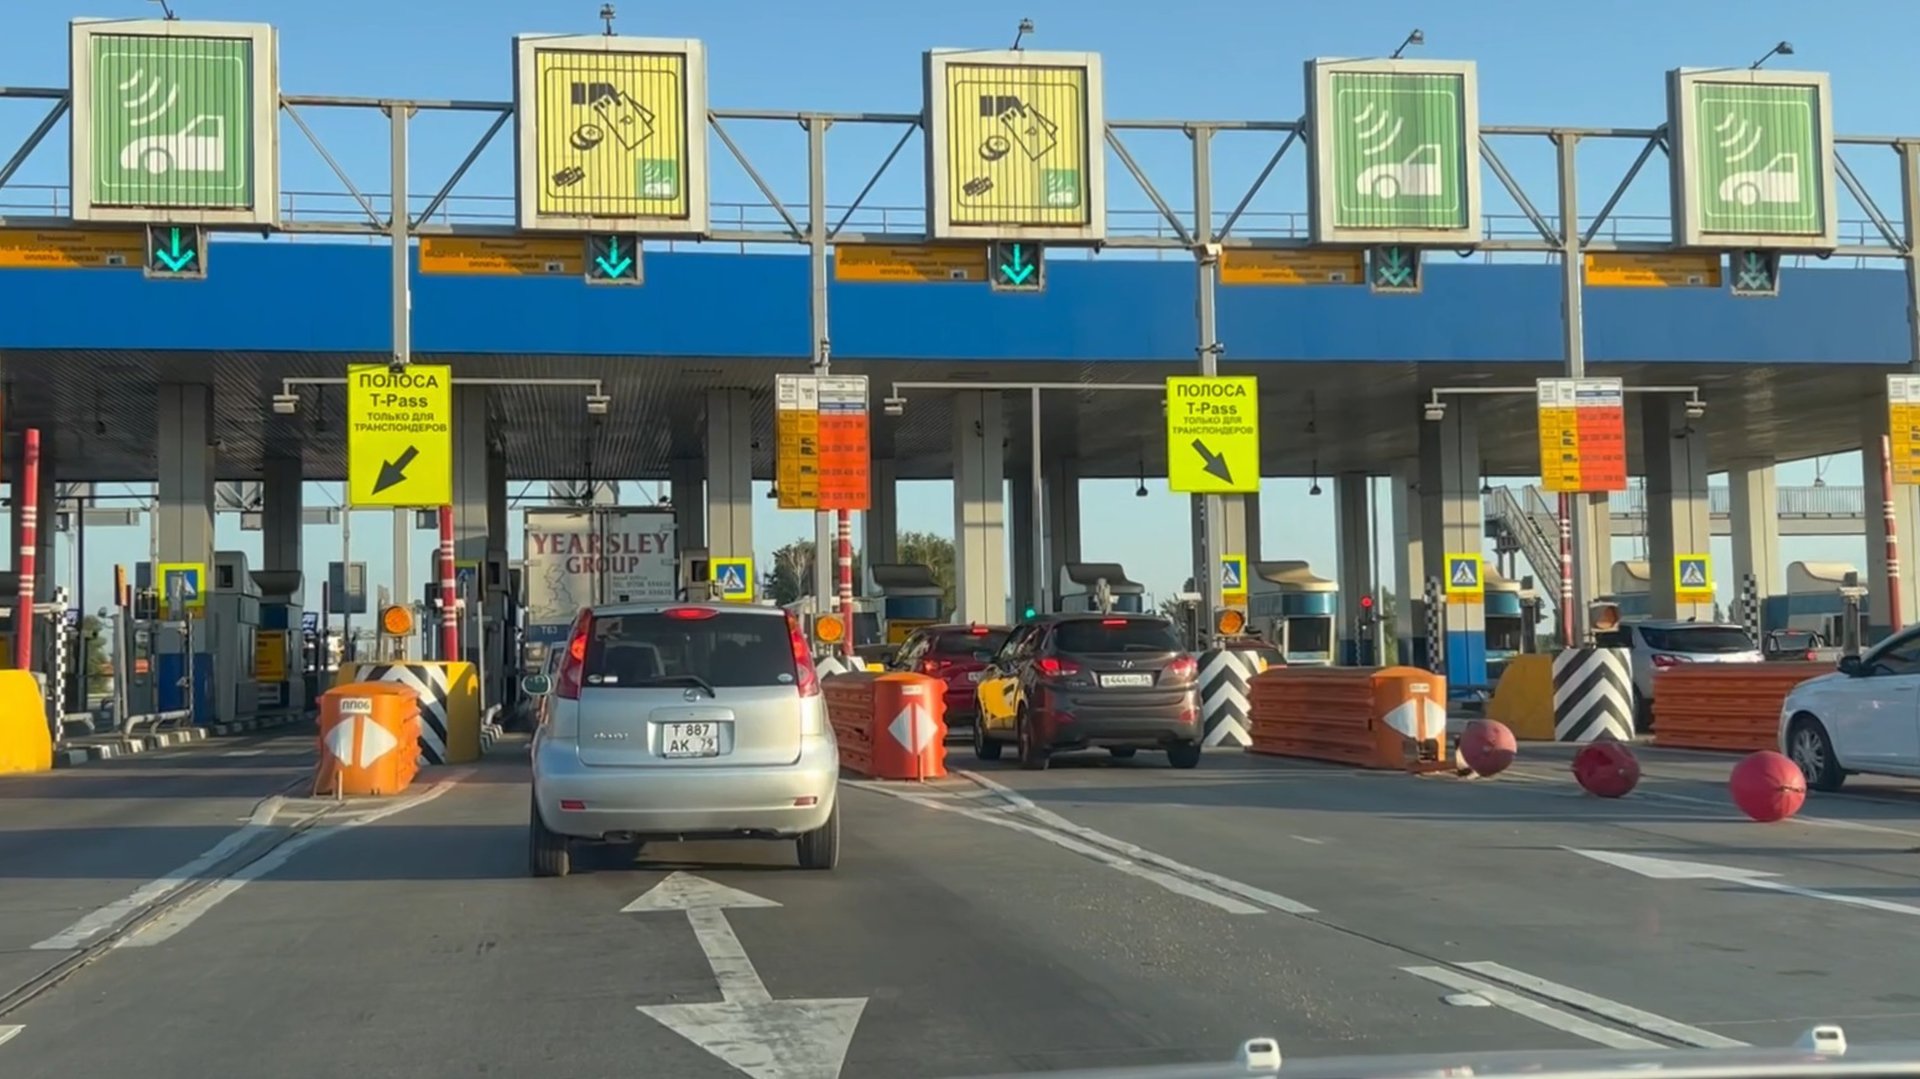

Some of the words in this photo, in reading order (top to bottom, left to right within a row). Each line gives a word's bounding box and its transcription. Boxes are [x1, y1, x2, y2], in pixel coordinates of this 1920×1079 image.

[359, 374, 438, 388] ПОЛОСА
[1177, 383, 1246, 397] ПОЛОСА
[370, 393, 428, 408] T-Pass
[1186, 402, 1237, 415] T-Pass
[367, 412, 409, 421] ТОЛЬКО
[411, 412, 434, 422] ДЛЯ
[1184, 416, 1221, 425] ТОЛЬКО
[1222, 416, 1242, 425] ДЛЯ
[354, 422, 447, 432] ТРАНСПОНДЕРОВ
[1172, 426, 1254, 435] ТРАНСПОНДЕРОВ
[531, 533, 671, 554] YEARSLEY
[566, 556, 640, 574] GROUP
[686, 724, 710, 736] 887
[670, 740, 690, 752] АК
